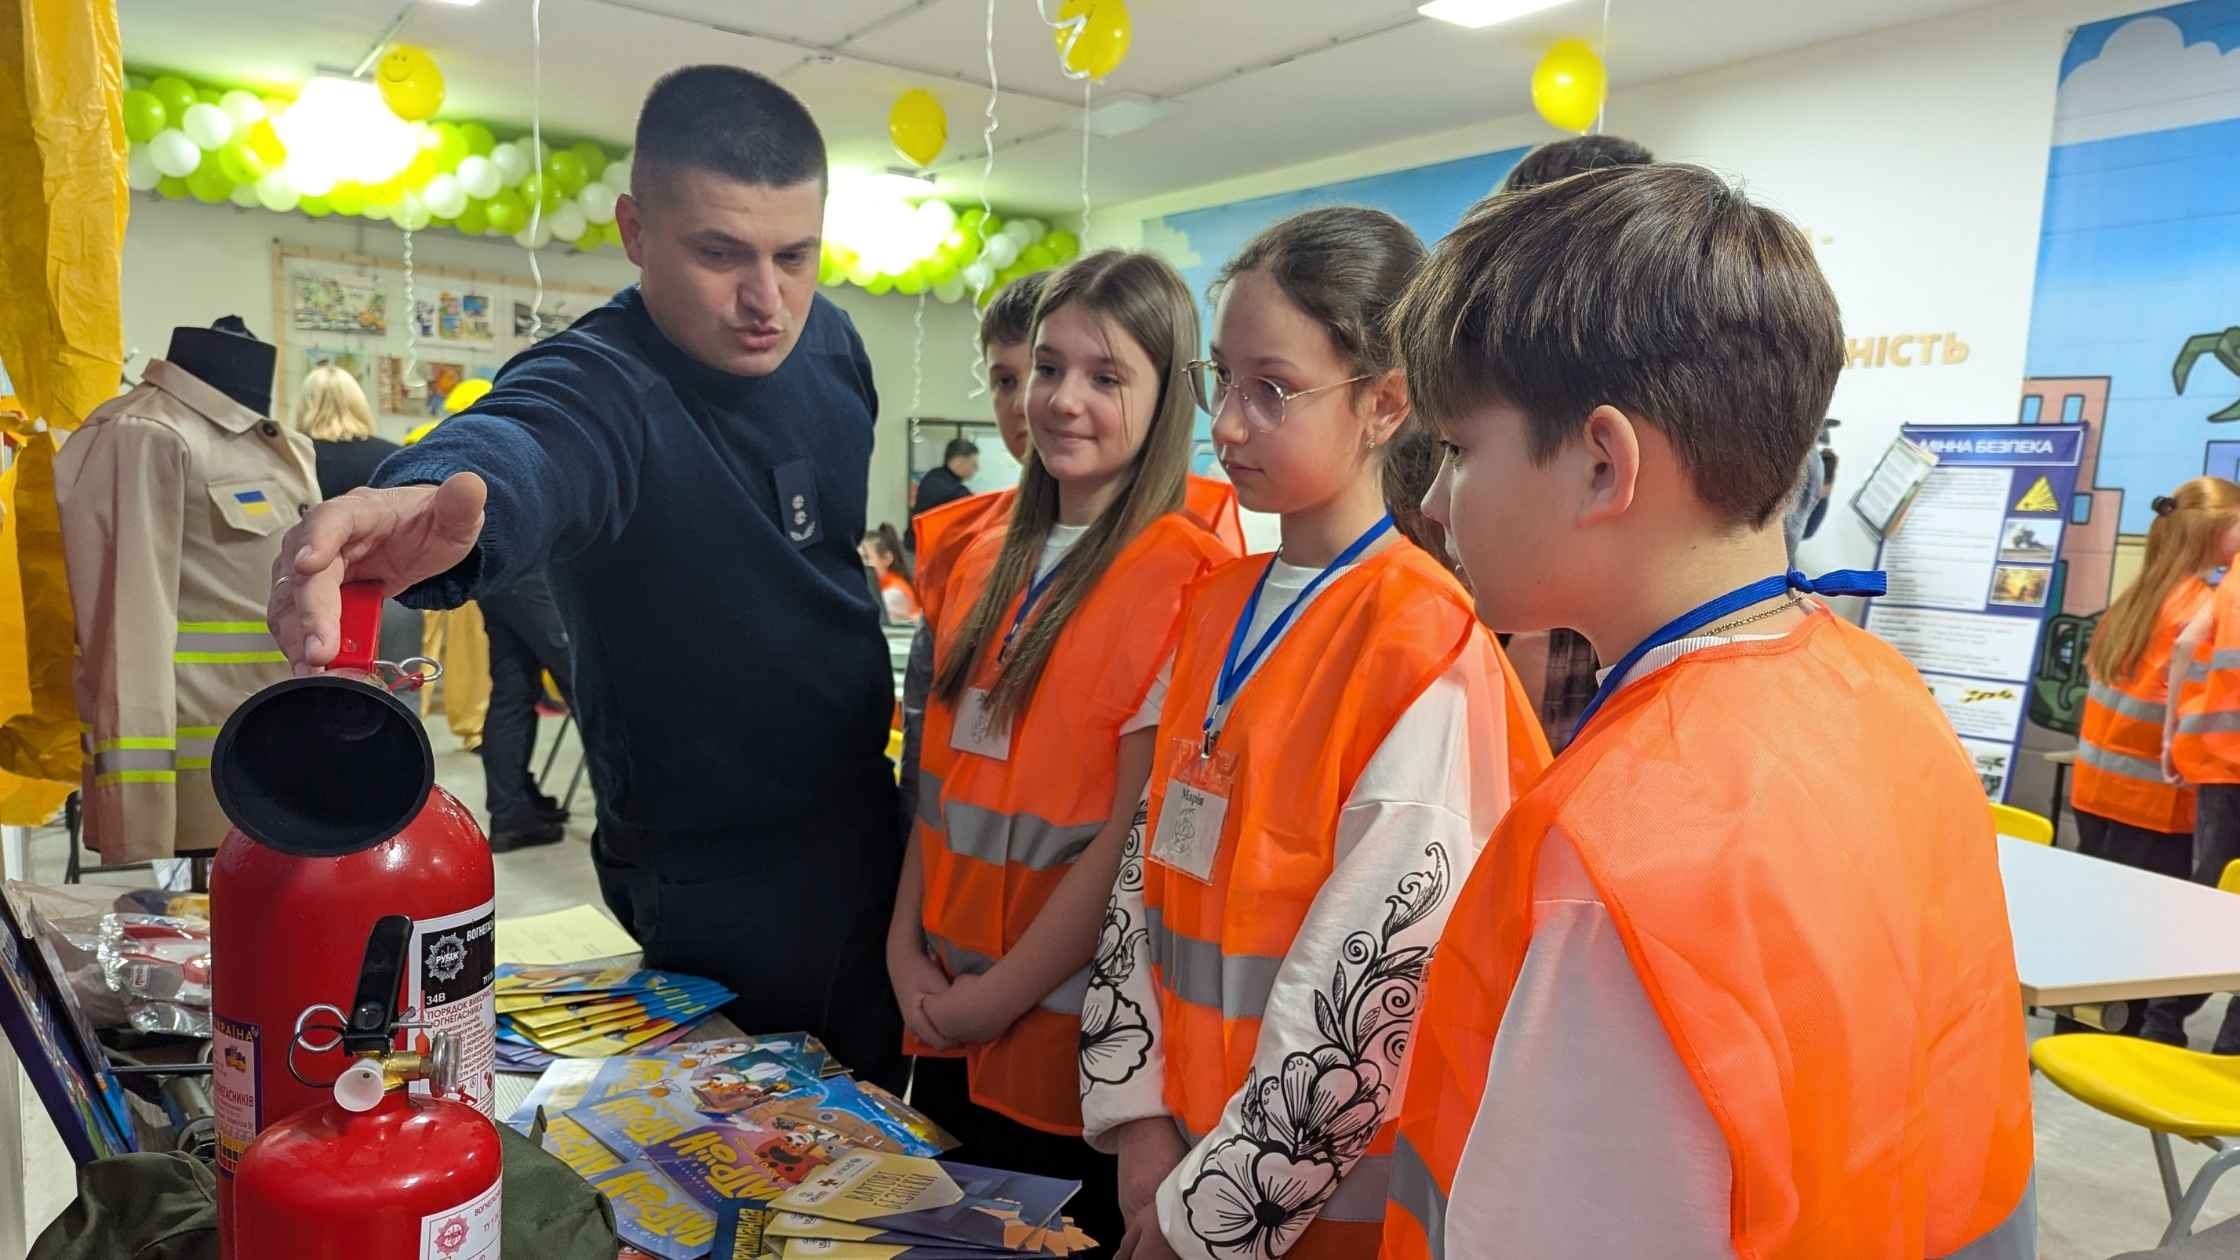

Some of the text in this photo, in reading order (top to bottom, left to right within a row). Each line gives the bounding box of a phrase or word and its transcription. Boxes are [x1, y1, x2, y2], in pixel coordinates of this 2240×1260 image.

[1975, 439, 2053, 453] БЕЗПЕКА
[428, 1001, 468, 1019] ПОРЯДОК
[431, 1003, 483, 1028] ОГНЕГАСНИКА
